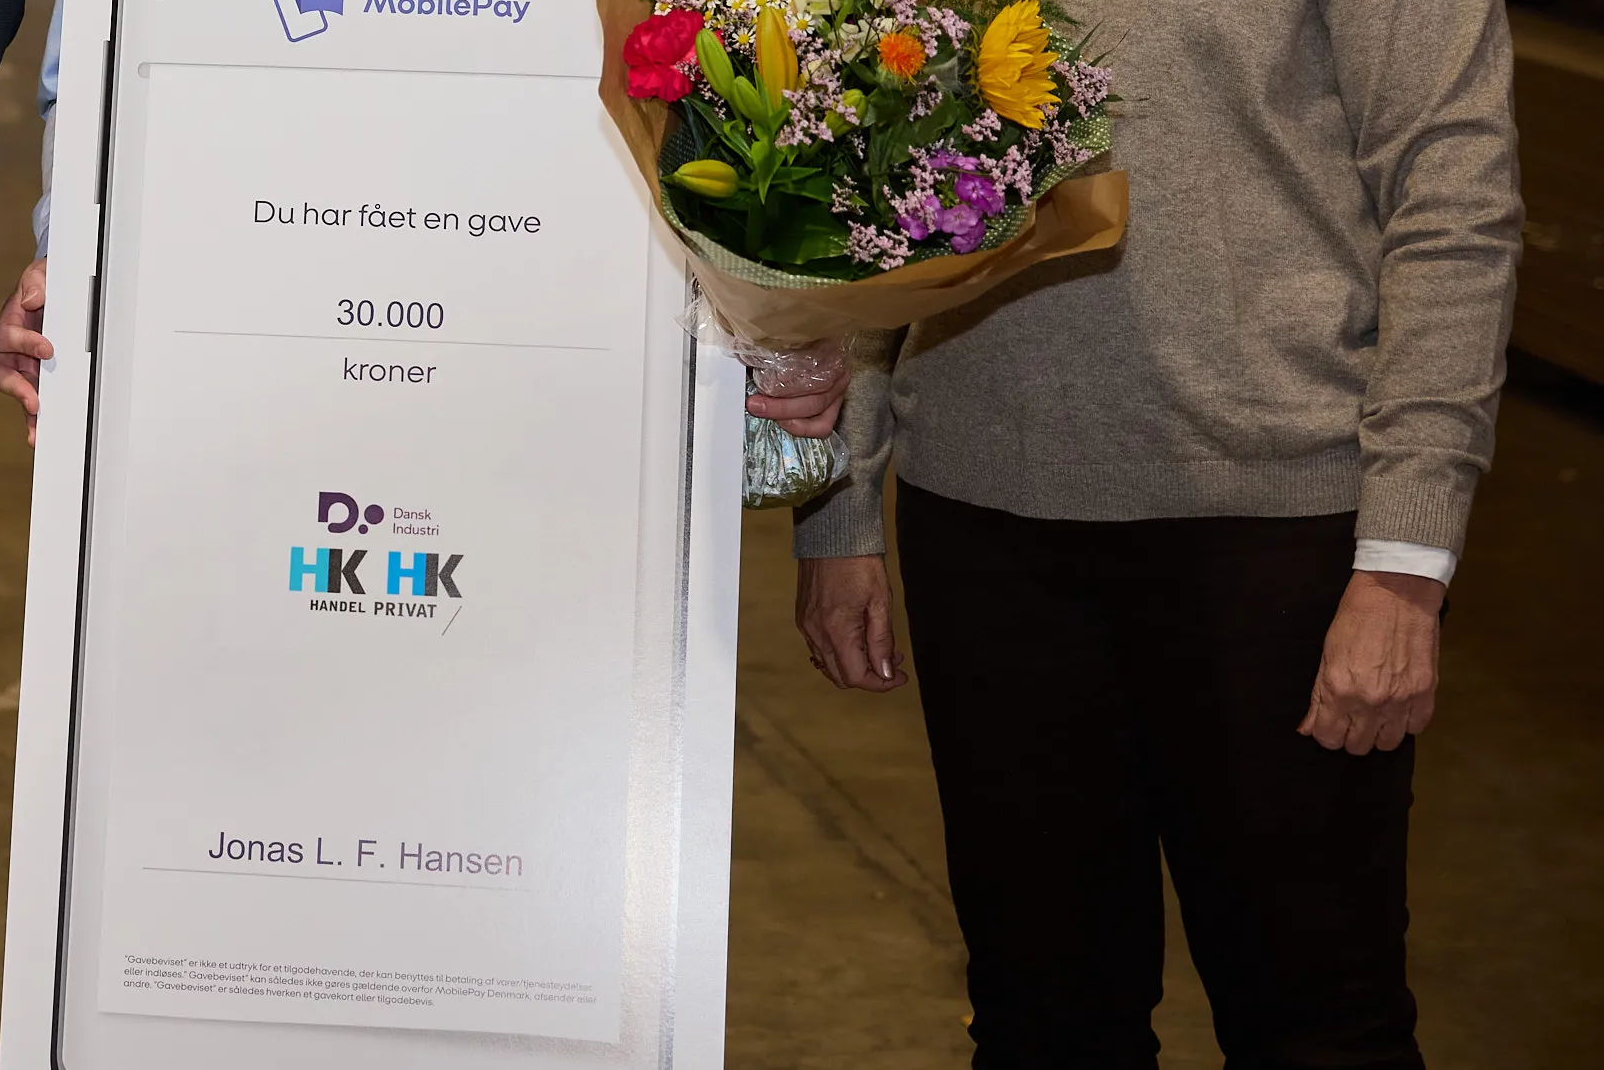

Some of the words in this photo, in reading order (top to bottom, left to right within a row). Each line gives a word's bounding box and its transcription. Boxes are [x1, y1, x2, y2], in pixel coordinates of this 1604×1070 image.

[255, 201, 294, 224] Du
[304, 202, 352, 226] har
[359, 204, 416, 229] fået
[424, 213, 459, 230] en
[468, 214, 542, 238] gave
[337, 299, 444, 329] 30.000
[344, 357, 437, 383] kroner
[393, 507, 432, 520] Dansk
[392, 523, 440, 536] Industri
[289, 546, 368, 595] HK
[387, 551, 464, 599] HK
[310, 599, 366, 613] HANDEL
[374, 602, 437, 618] PRIVAT
[208, 832, 304, 865] Jonas
[315, 838, 343, 866] L.
[356, 840, 385, 868] F.
[400, 842, 524, 877] Hansen
[124, 967, 143, 976] eller
[250, 975, 267, 983] kan
[268, 975, 303, 986] således
[306, 978, 322, 987] ikke
[325, 980, 350, 990] gøres
[352, 982, 399, 992] gældende
[401, 984, 433, 994] overfor
[435, 986, 485, 999] MobilePay
[487, 990, 532, 1001] Denmark,
[534, 992, 575, 1003] afsender
[200, 958, 217, 968] ikke
[219, 961, 227, 969] et
[229, 961, 257, 971] udtryk
[260, 963, 271, 972] for
[284, 965, 357, 978] tilgodehavende,
[359, 969, 374, 978] der
[376, 970, 393, 979] kan
[395, 971, 433, 982] benyttes
[436, 974, 444, 982] til
[445, 975, 483, 987] betaling
[485, 977, 494, 986] af
[123, 979, 152, 989] andre.
[218, 985, 227, 993] er
[229, 985, 264, 996] således
[266, 988, 301, 997] hverken
[303, 991, 312, 999] et
[314, 991, 354, 1002] gavekort
[355, 993, 375, 1002] eller
[377, 995, 434, 1006] tilgodebevis.
